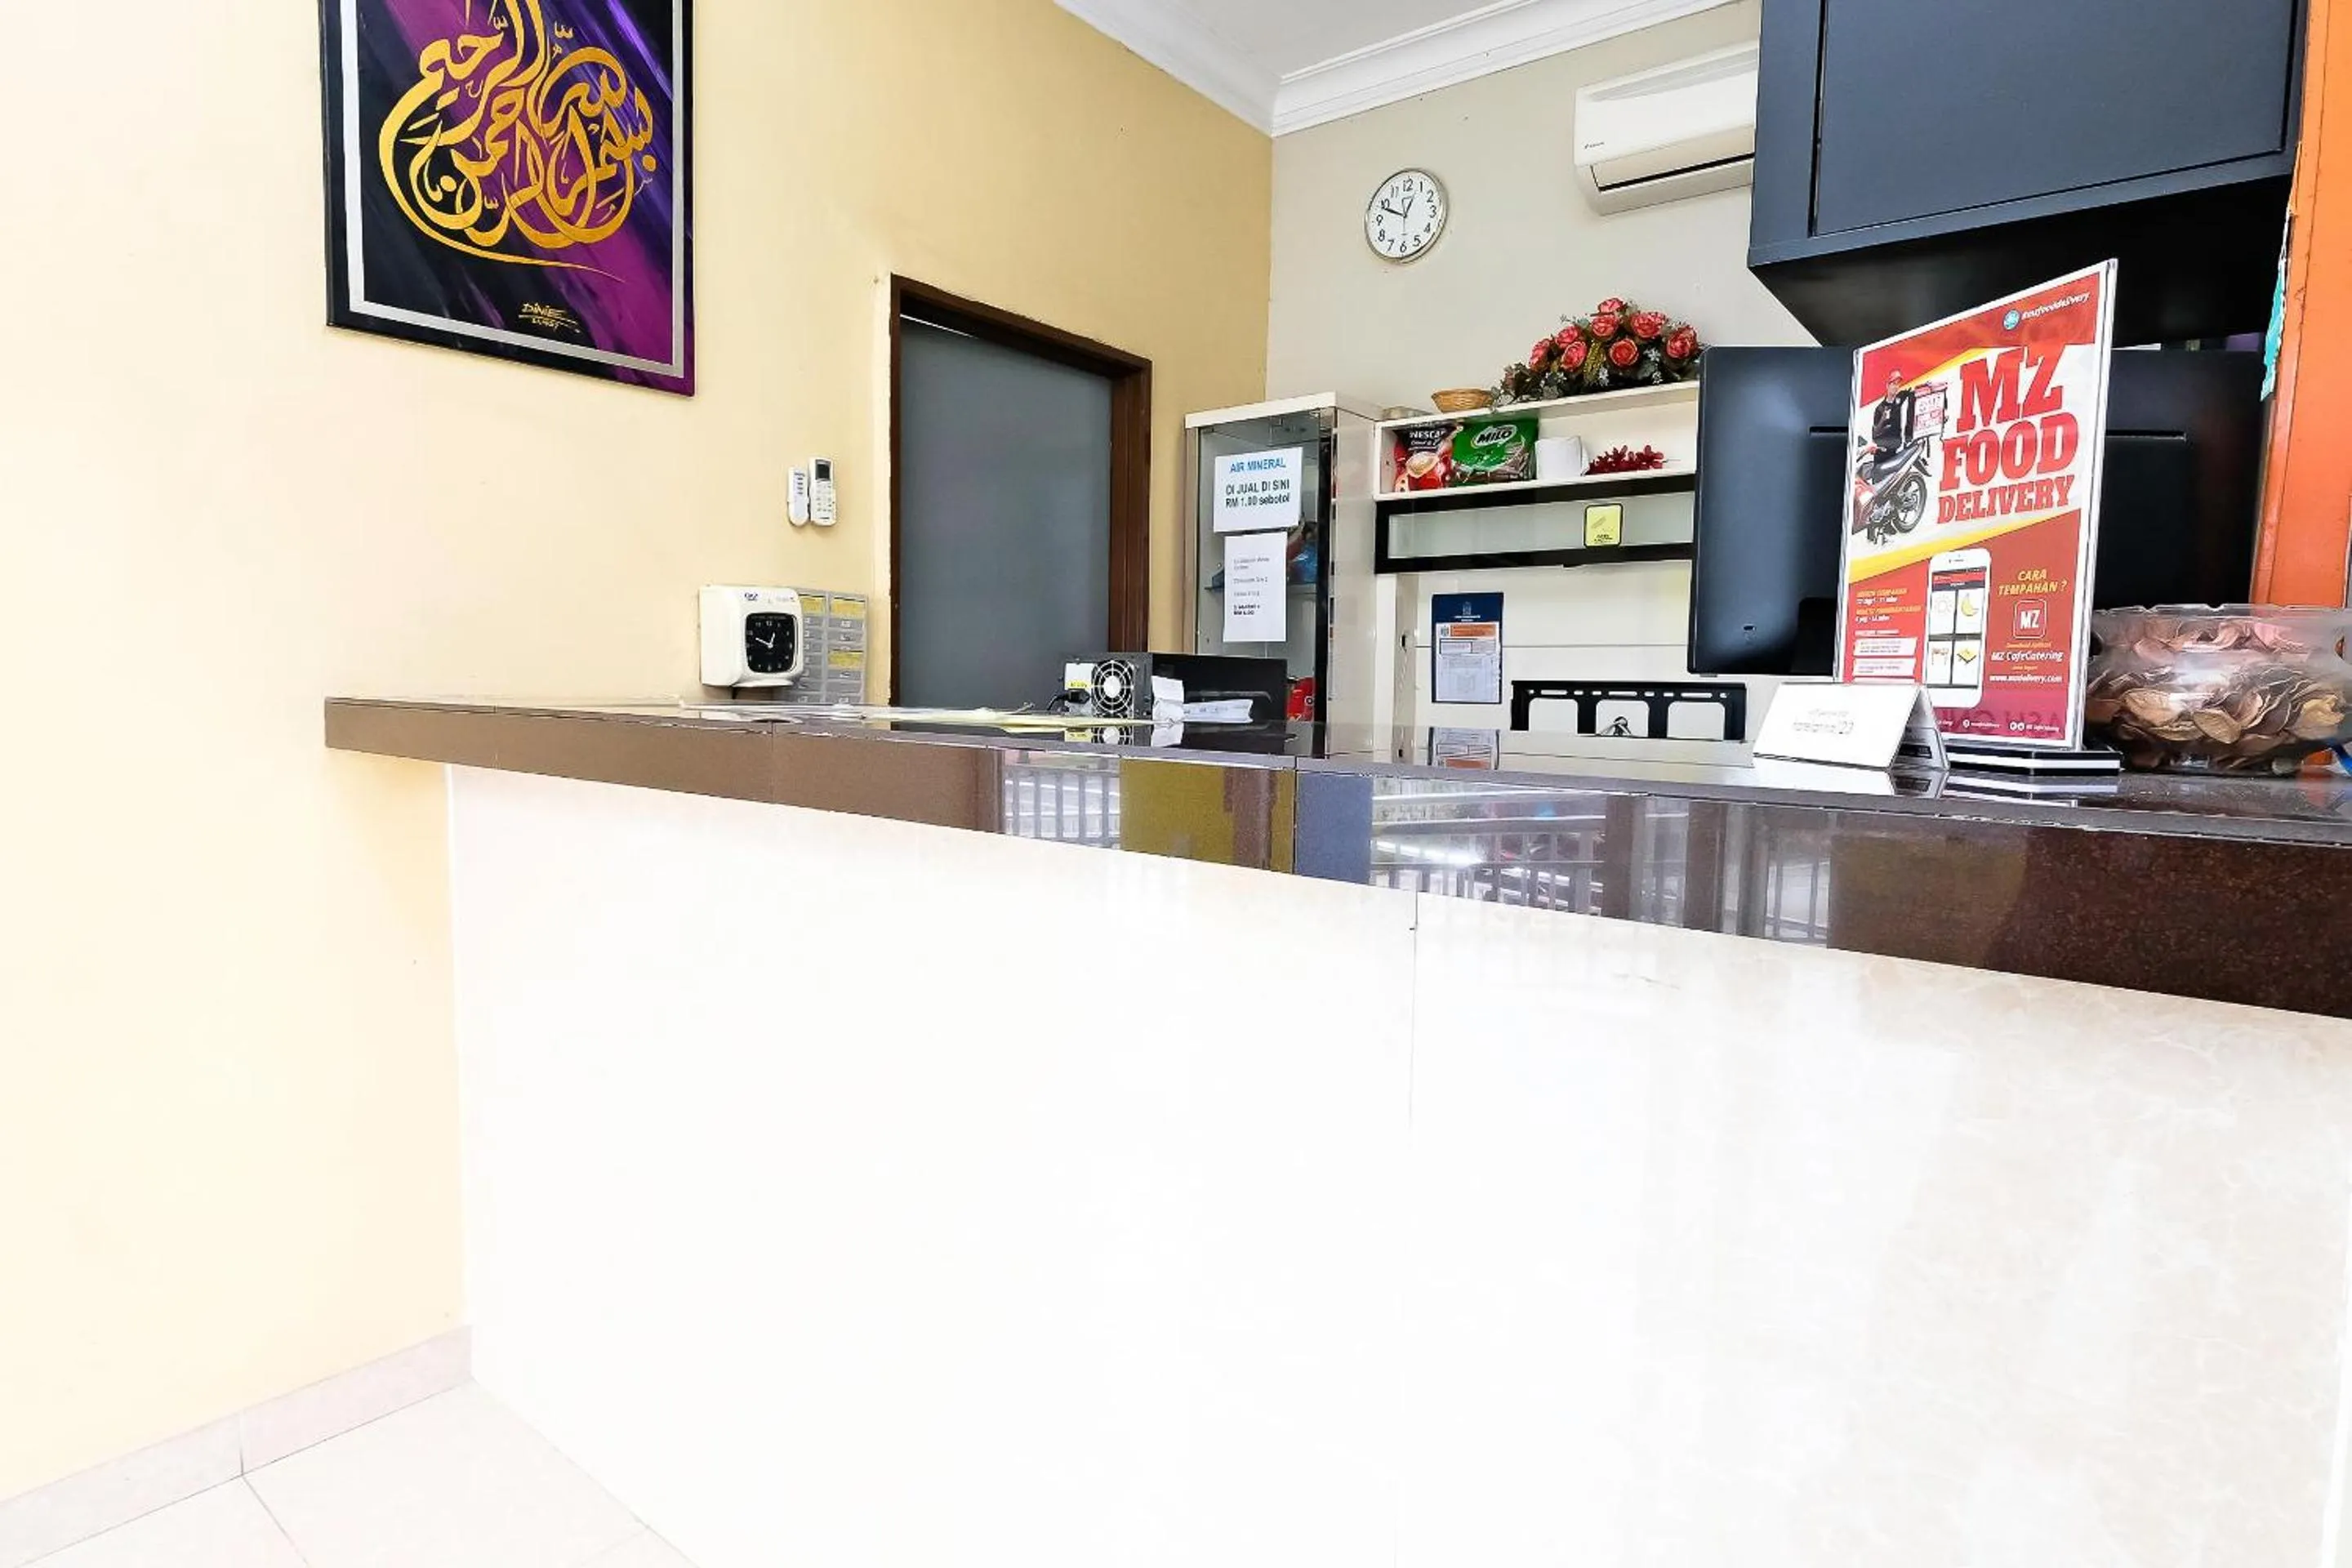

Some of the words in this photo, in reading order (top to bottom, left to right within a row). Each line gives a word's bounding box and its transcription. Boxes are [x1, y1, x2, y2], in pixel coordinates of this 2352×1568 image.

[1403, 178, 1413, 192] 12
[1427, 189, 1434, 203] 2
[1429, 205, 1437, 218] 3
[1376, 214, 1383, 226] 9
[1423, 222, 1431, 233] 4
[1378, 229, 1385, 242] 8
[1413, 234, 1421, 247] 5
[1388, 239, 1395, 252] 7
[1400, 241, 1407, 253] 6
[1957, 339, 2064, 433] MZ
[1477, 429, 1512, 444] MILO
[1940, 412, 2078, 491] FOOD
[1230, 461, 1245, 473] AIR
[1247, 457, 1286, 471] MINERAL
[1236, 482, 1259, 495] JUAL
[1262, 480, 1271, 492] DI
[1226, 497, 1238, 508] RM
[1937, 474, 2075, 524] DELIVERY
[2017, 569, 2048, 581] CARA
[1998, 581, 2059, 595] TEMPAHAN
[2020, 609, 2041, 630] MZ
[1991, 652, 2005, 661] MZ
